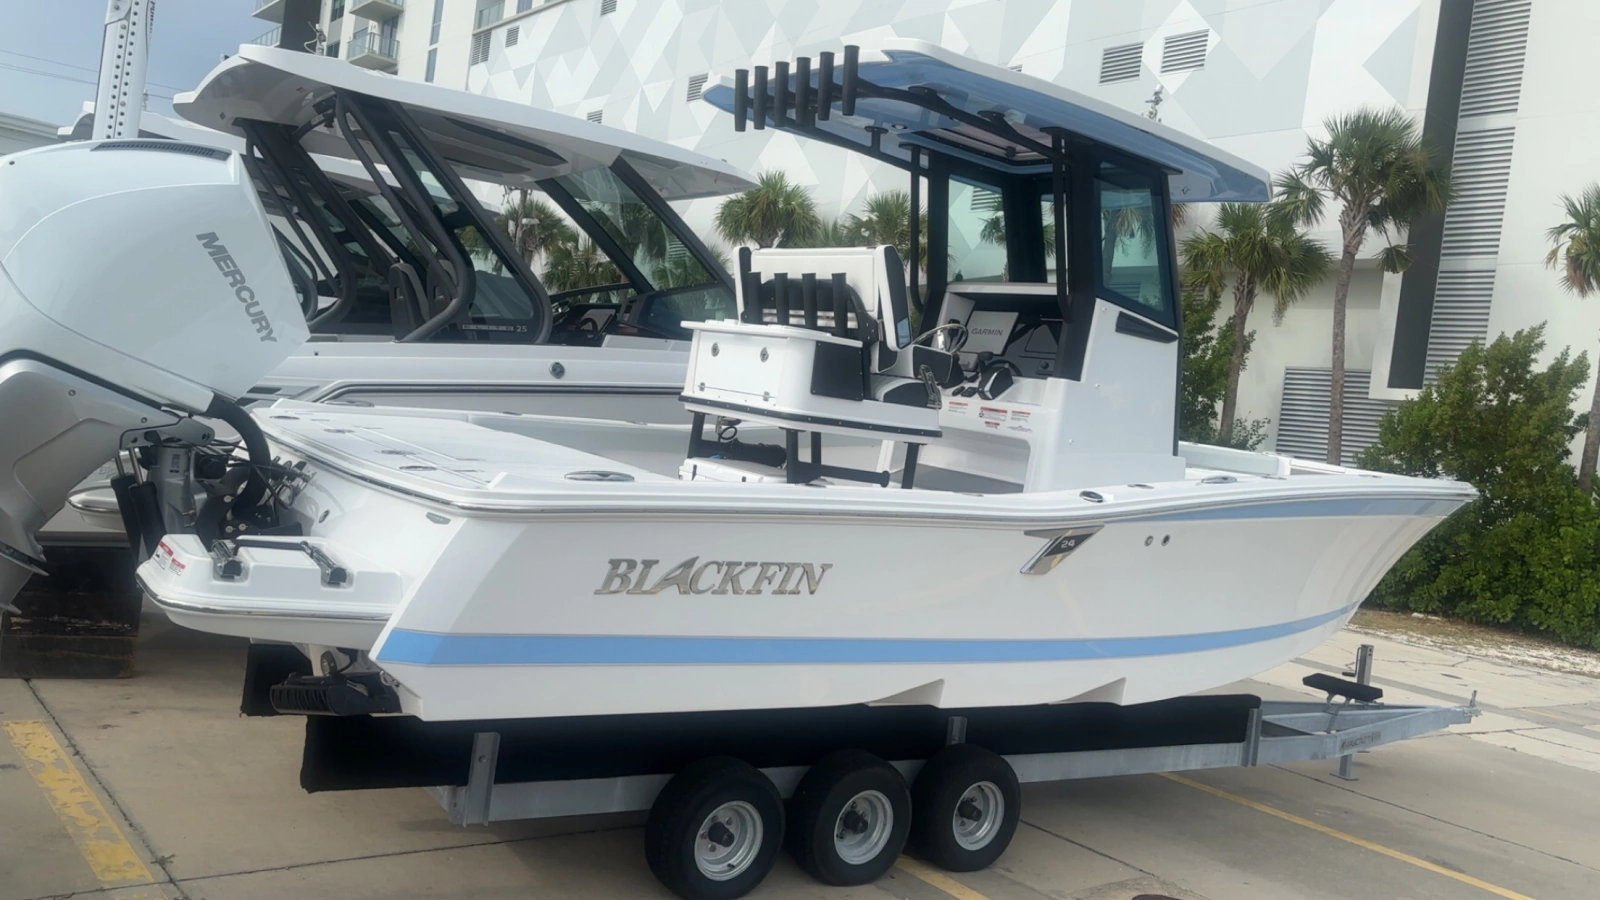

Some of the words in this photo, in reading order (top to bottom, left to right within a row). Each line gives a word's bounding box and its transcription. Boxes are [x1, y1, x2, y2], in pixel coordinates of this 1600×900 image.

[196, 232, 277, 342] MERCURY
[516, 325, 528, 333] 25
[971, 327, 1004, 336] GARMIN
[1060, 539, 1075, 549] 24
[593, 556, 833, 595] BLACKFIN
